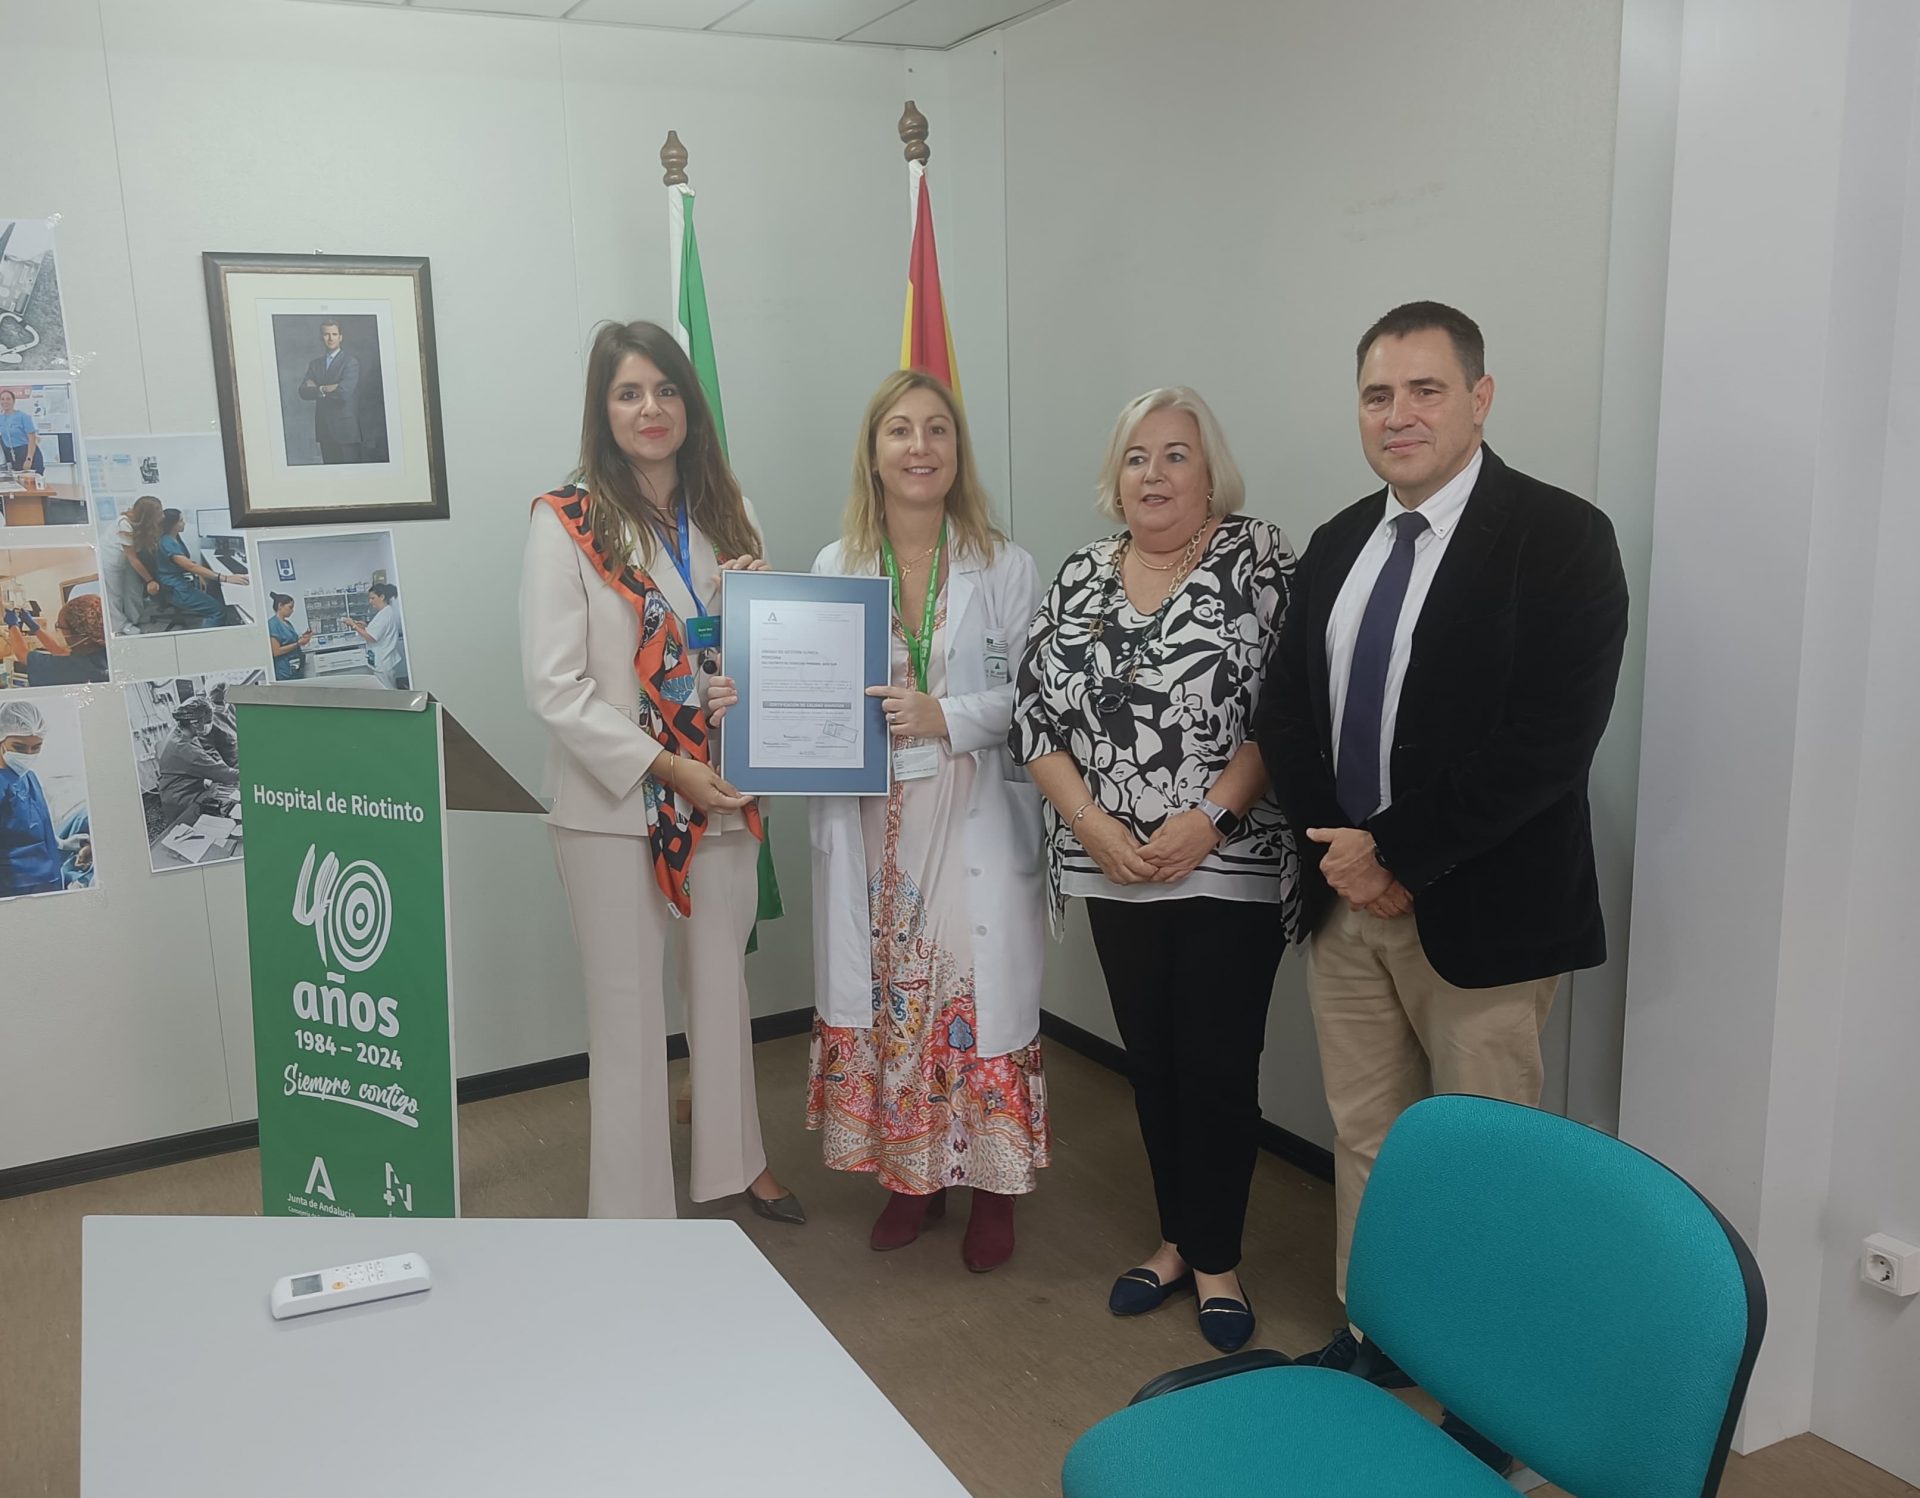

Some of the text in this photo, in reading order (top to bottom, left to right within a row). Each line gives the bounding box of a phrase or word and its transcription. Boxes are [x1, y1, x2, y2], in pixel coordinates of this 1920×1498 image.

[253, 784, 424, 823] Hospital de Riotinto
[292, 843, 393, 972] 40
[292, 971, 400, 1037] años
[294, 1029, 337, 1056] 1984
[356, 1042, 403, 1071] 2024
[283, 1062, 419, 1116] Siempre contigo
[287, 1193, 308, 1205] Junta
[309, 1199, 318, 1209] de
